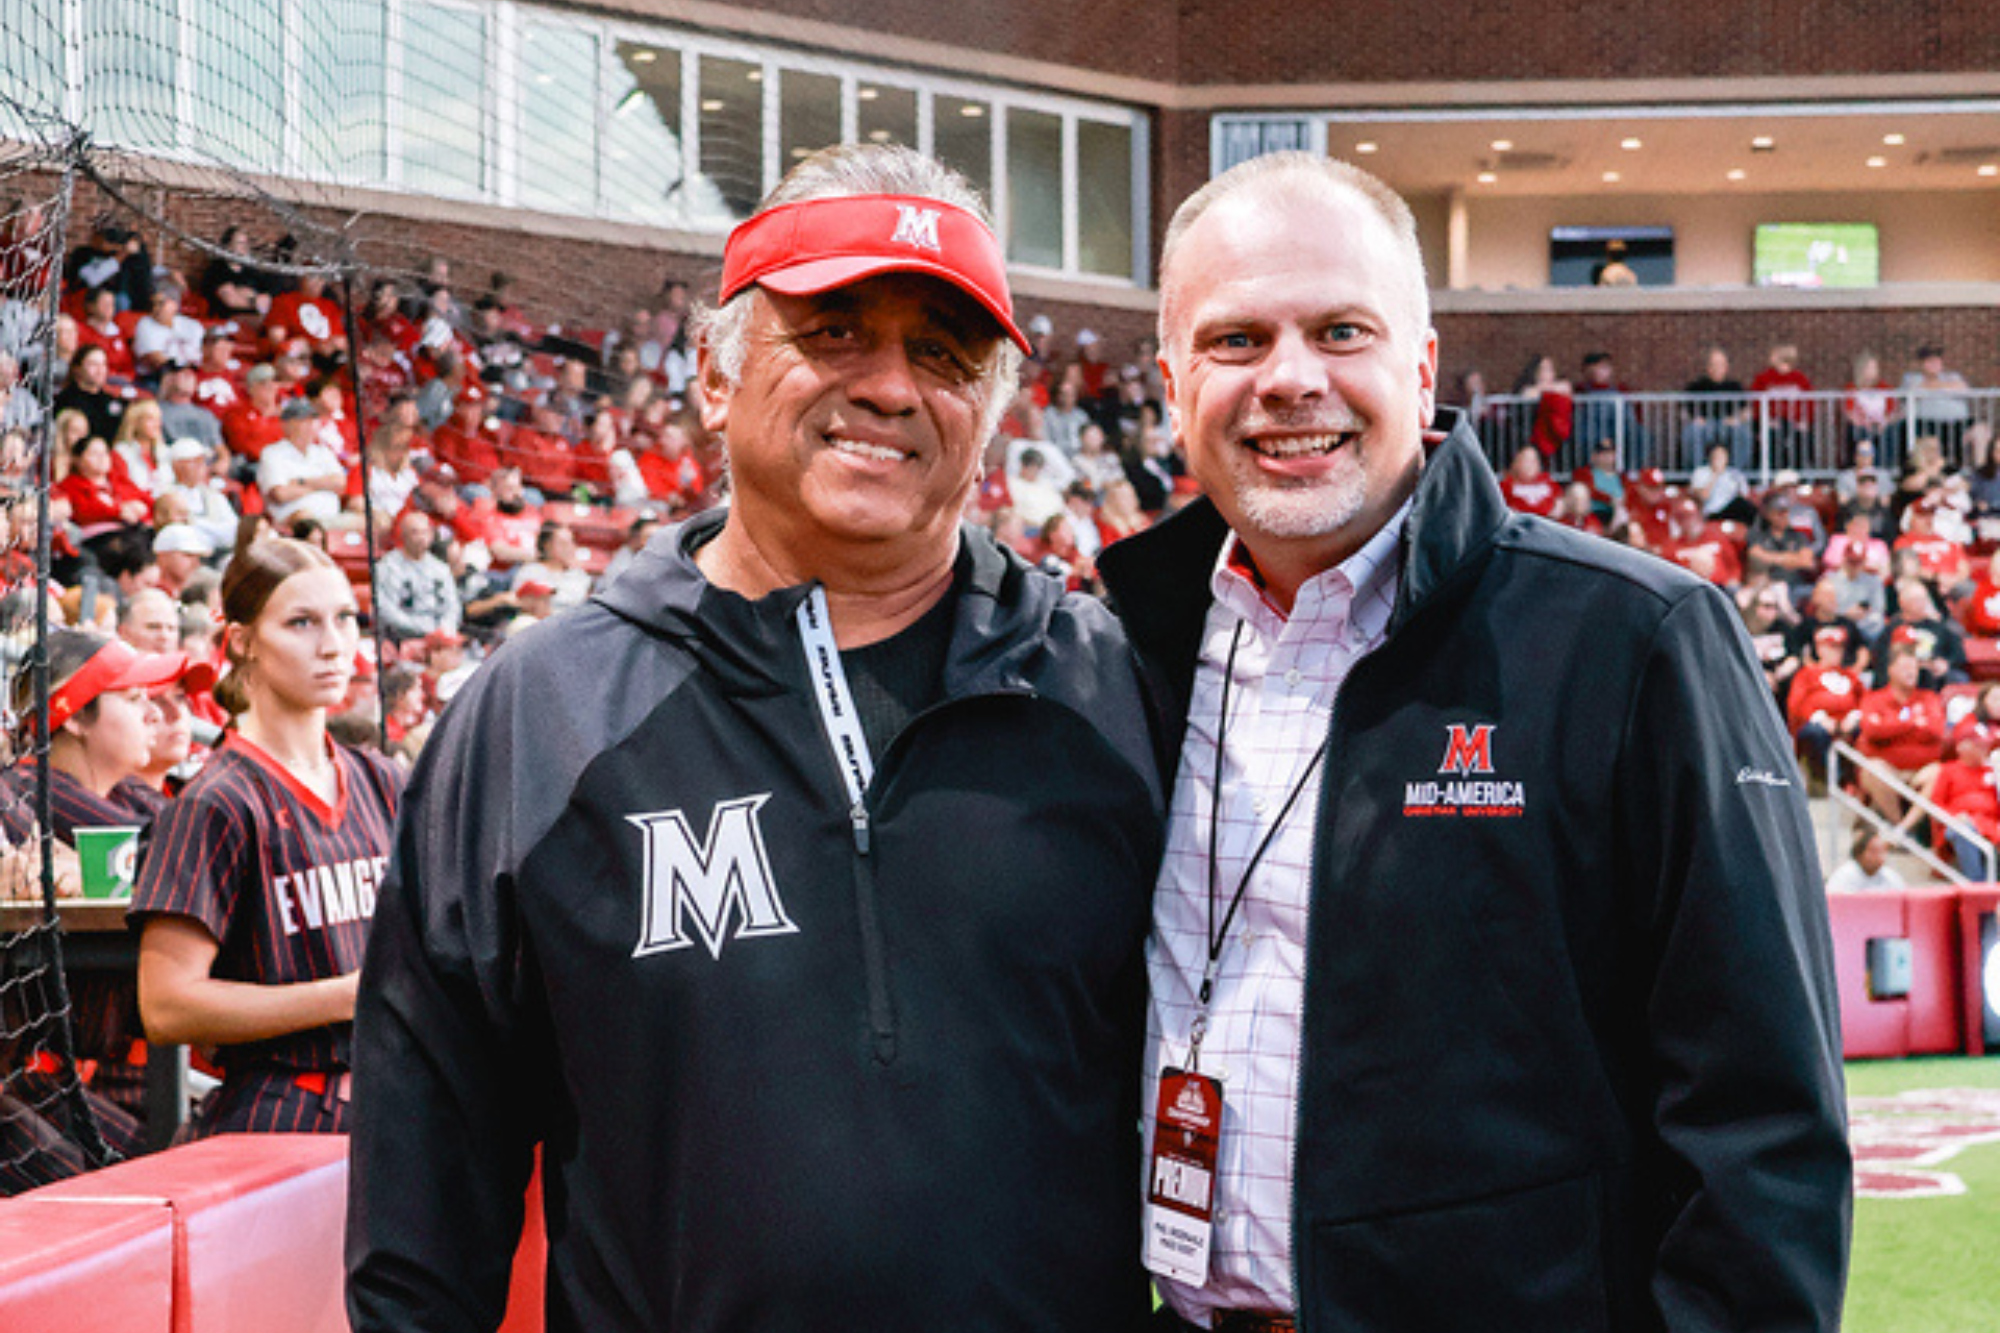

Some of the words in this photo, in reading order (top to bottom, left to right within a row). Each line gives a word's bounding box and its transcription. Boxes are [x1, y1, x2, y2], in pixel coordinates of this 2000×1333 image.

[890, 203, 941, 254] M
[1437, 722, 1497, 778] M
[1405, 781, 1525, 806] MID-AMERICA
[624, 791, 801, 962] M
